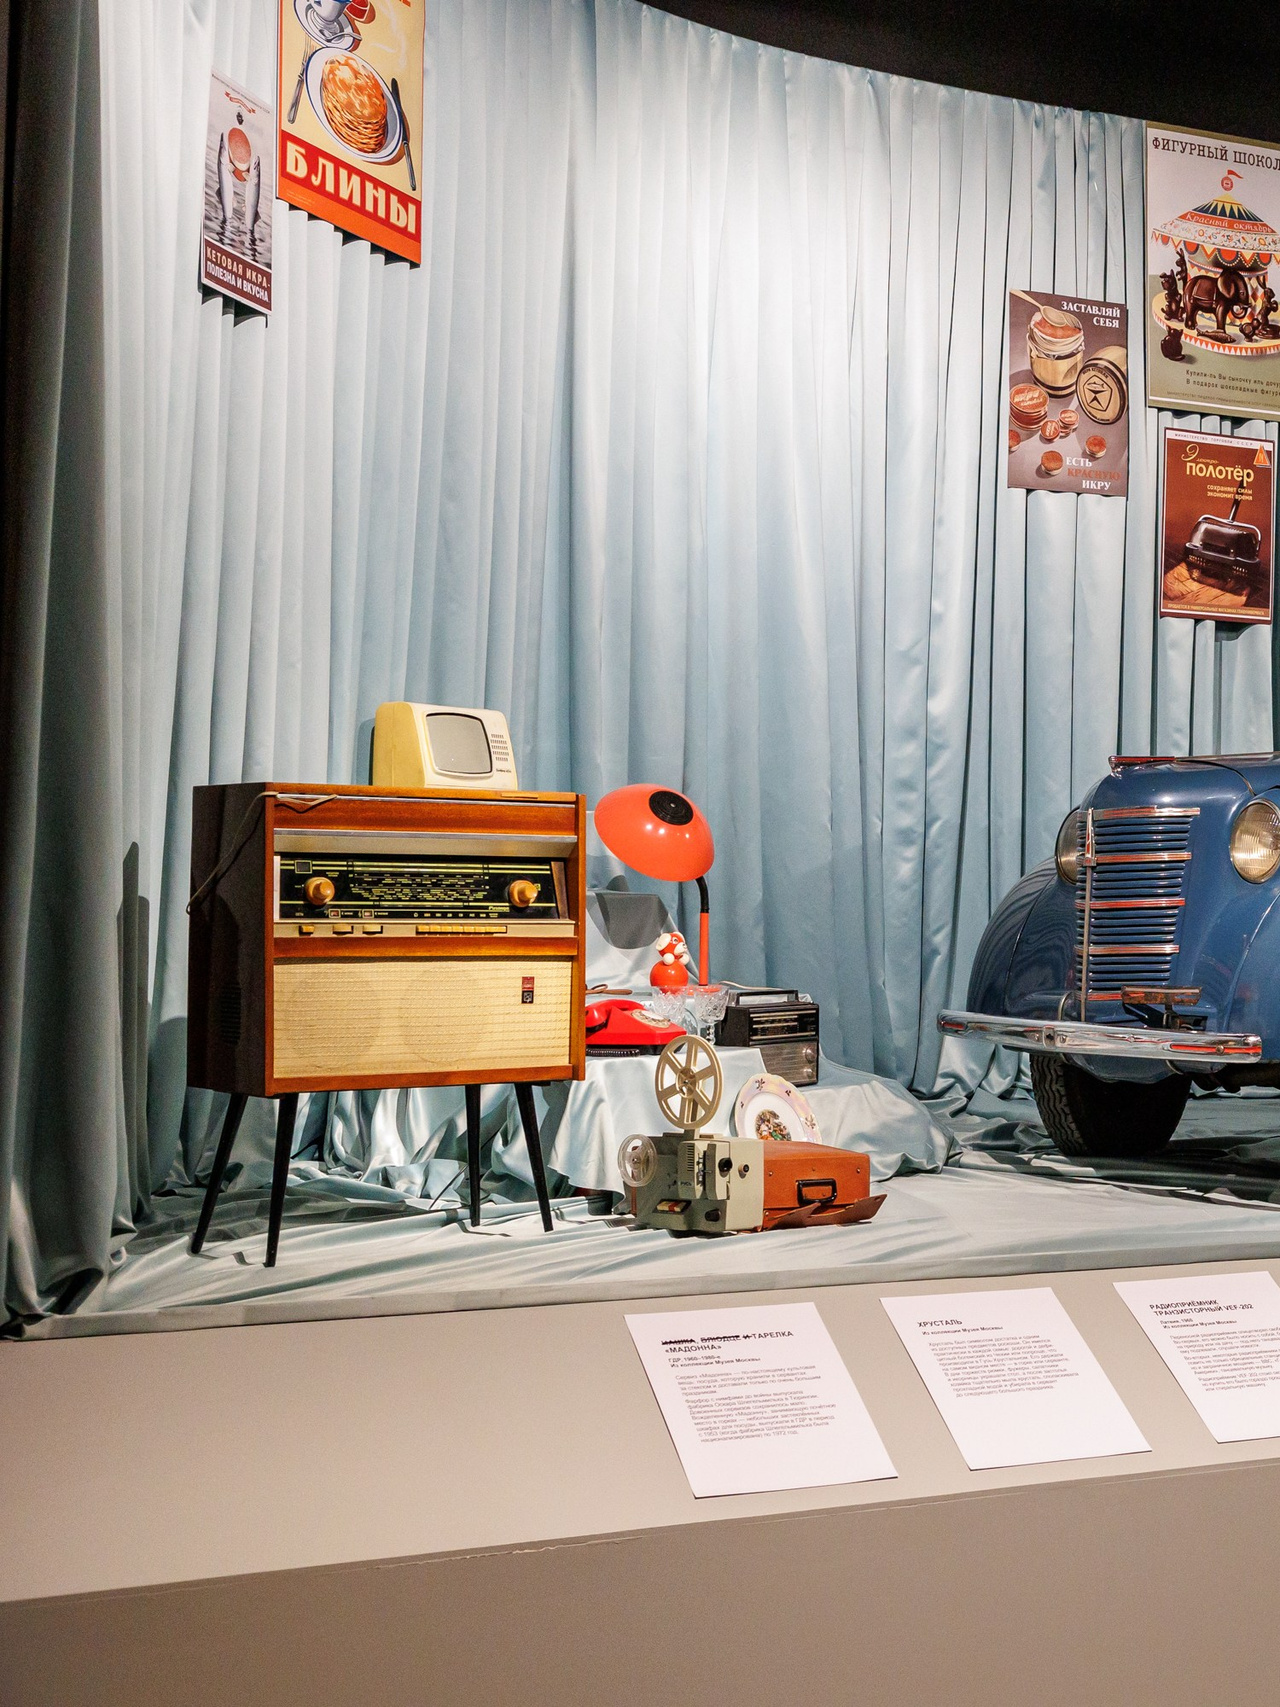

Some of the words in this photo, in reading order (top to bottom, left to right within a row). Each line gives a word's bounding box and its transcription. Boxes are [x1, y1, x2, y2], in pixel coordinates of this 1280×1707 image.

[1152, 136, 1229, 162] ФИГУРНЫЙ
[285, 139, 417, 235] БЛИНЫ
[1185, 213, 1229, 228] Красный
[206, 246, 243, 276] КЕТОВАЯ
[206, 260, 236, 287] ПОЛЕЗНА
[236, 276, 242, 290] И
[1061, 300, 1120, 318] ЗАСТАВЛЯЙ
[1092, 316, 1120, 328] СЕБЯ
[1066, 456, 1092, 468] ЕСТЬ
[1067, 467, 1121, 479] КРАСНУЮ
[1082, 480, 1111, 491] ИКРУ
[1206, 484, 1236, 493] сохраняет
[1206, 491, 1234, 499] экономит
[1149, 1299, 1219, 1310] РАДИОПРИЁМНИК
[917, 1319, 963, 1328] ХРУСТАЛЬ
[752, 1331, 793, 1339] ТАРЕЛКА
[665, 1344, 722, 1353] «МАДОННА»
